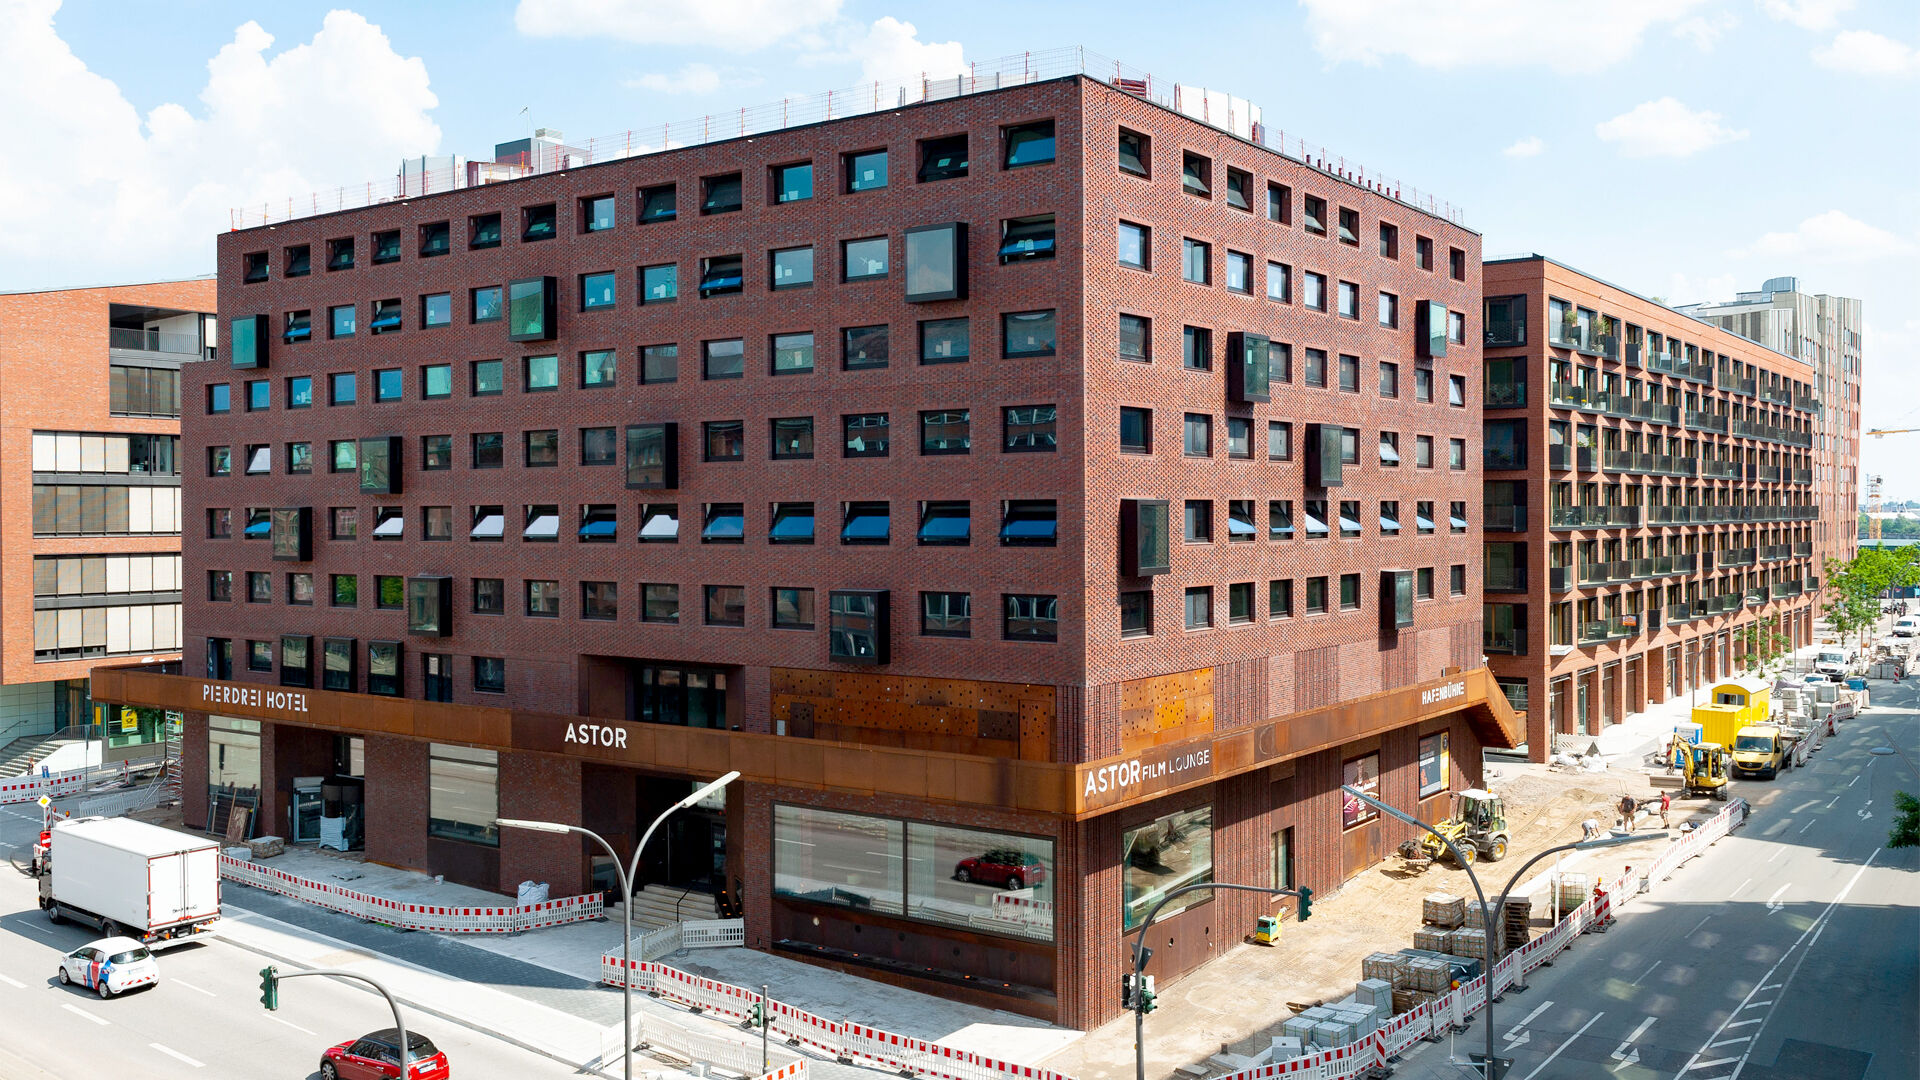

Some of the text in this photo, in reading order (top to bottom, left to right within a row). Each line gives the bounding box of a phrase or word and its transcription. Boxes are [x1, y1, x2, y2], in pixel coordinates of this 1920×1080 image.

[203, 684, 308, 712] PIERDREI HOTEL
[1421, 681, 1465, 705] HAFENBÜHNE
[564, 722, 627, 749] ASTOR
[1084, 749, 1210, 797] ASTOR FILM LOUNGE
